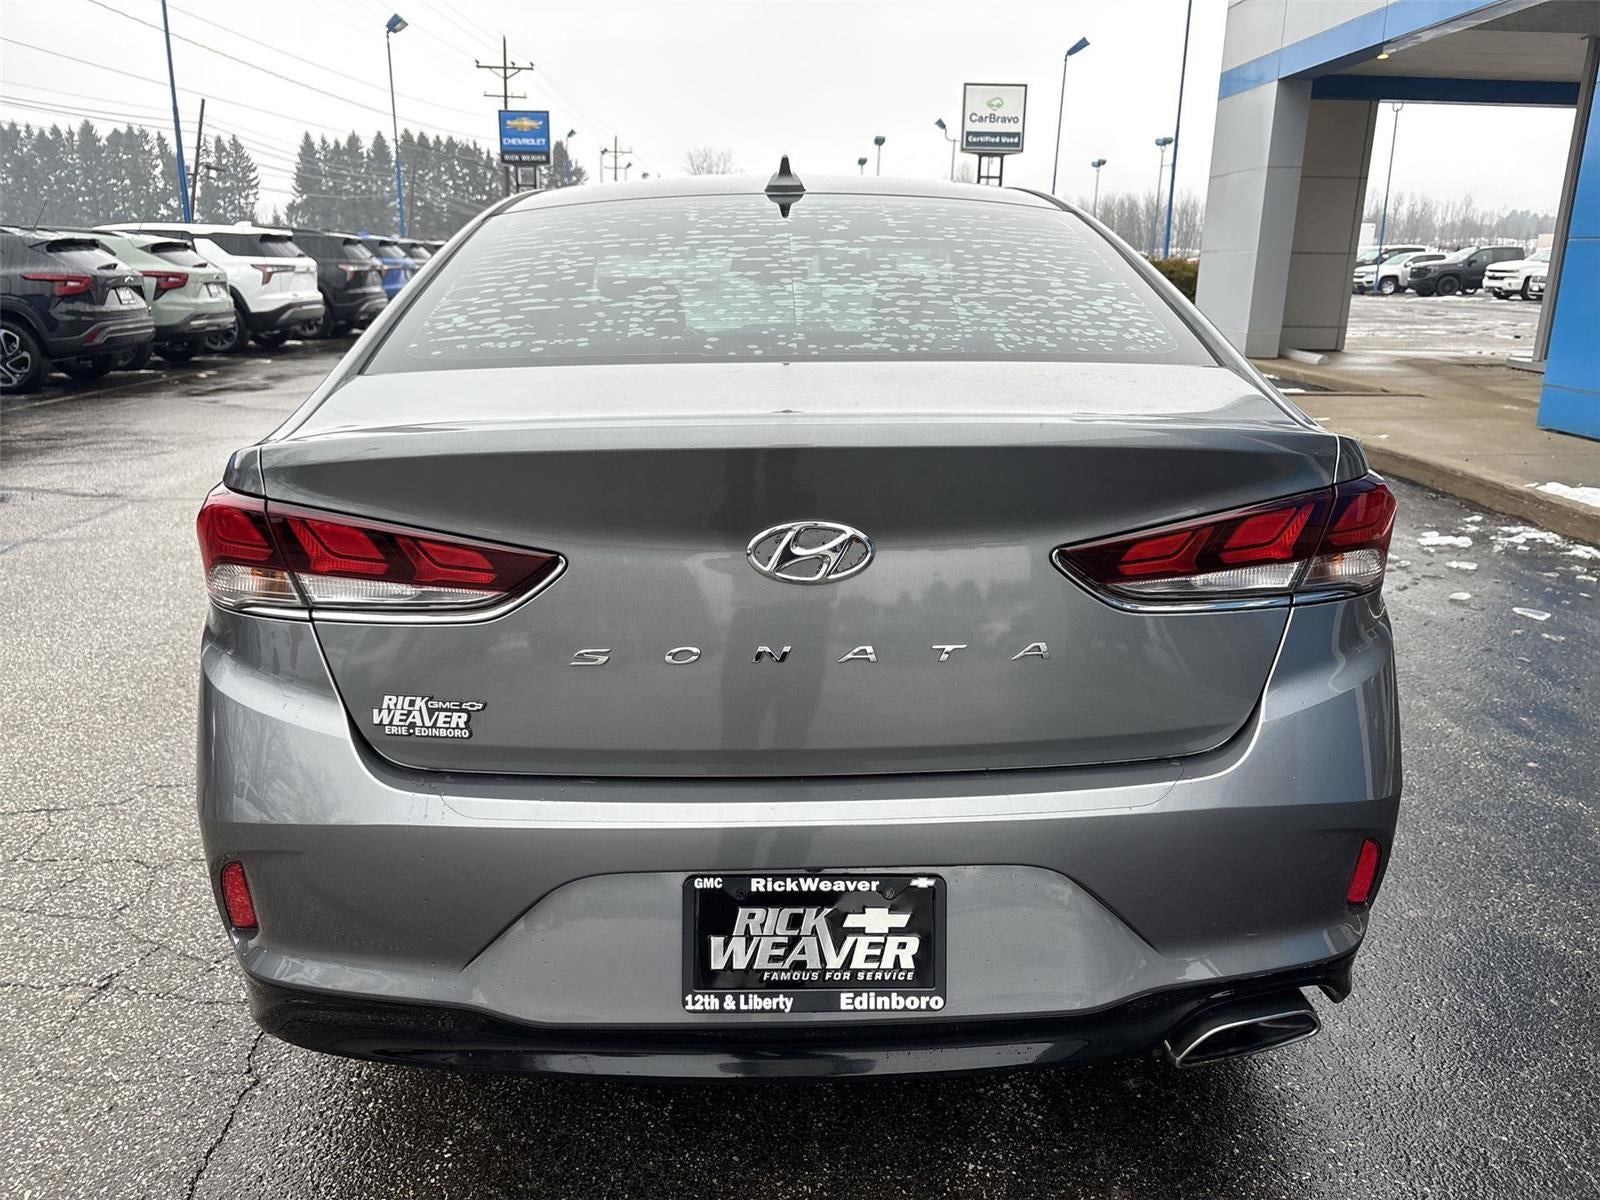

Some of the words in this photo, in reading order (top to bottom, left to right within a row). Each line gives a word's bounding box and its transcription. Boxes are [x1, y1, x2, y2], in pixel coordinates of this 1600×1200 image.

[969, 112, 1019, 124] CarBravo
[382, 695, 429, 710] RICK
[428, 701, 461, 709] GMC
[372, 708, 468, 728] WEAVER
[694, 878, 723, 888] GMC
[732, 907, 836, 936] RICK
[710, 936, 920, 970] WEAVER
[763, 972, 819, 980] FAMOUS
[825, 972, 850, 980] FOR
[857, 972, 914, 980] SERVICE
[684, 994, 719, 1010] 12th
[724, 994, 736, 1010] &
[739, 994, 793, 1012] Liberty
[840, 992, 944, 1010] Edinboro
